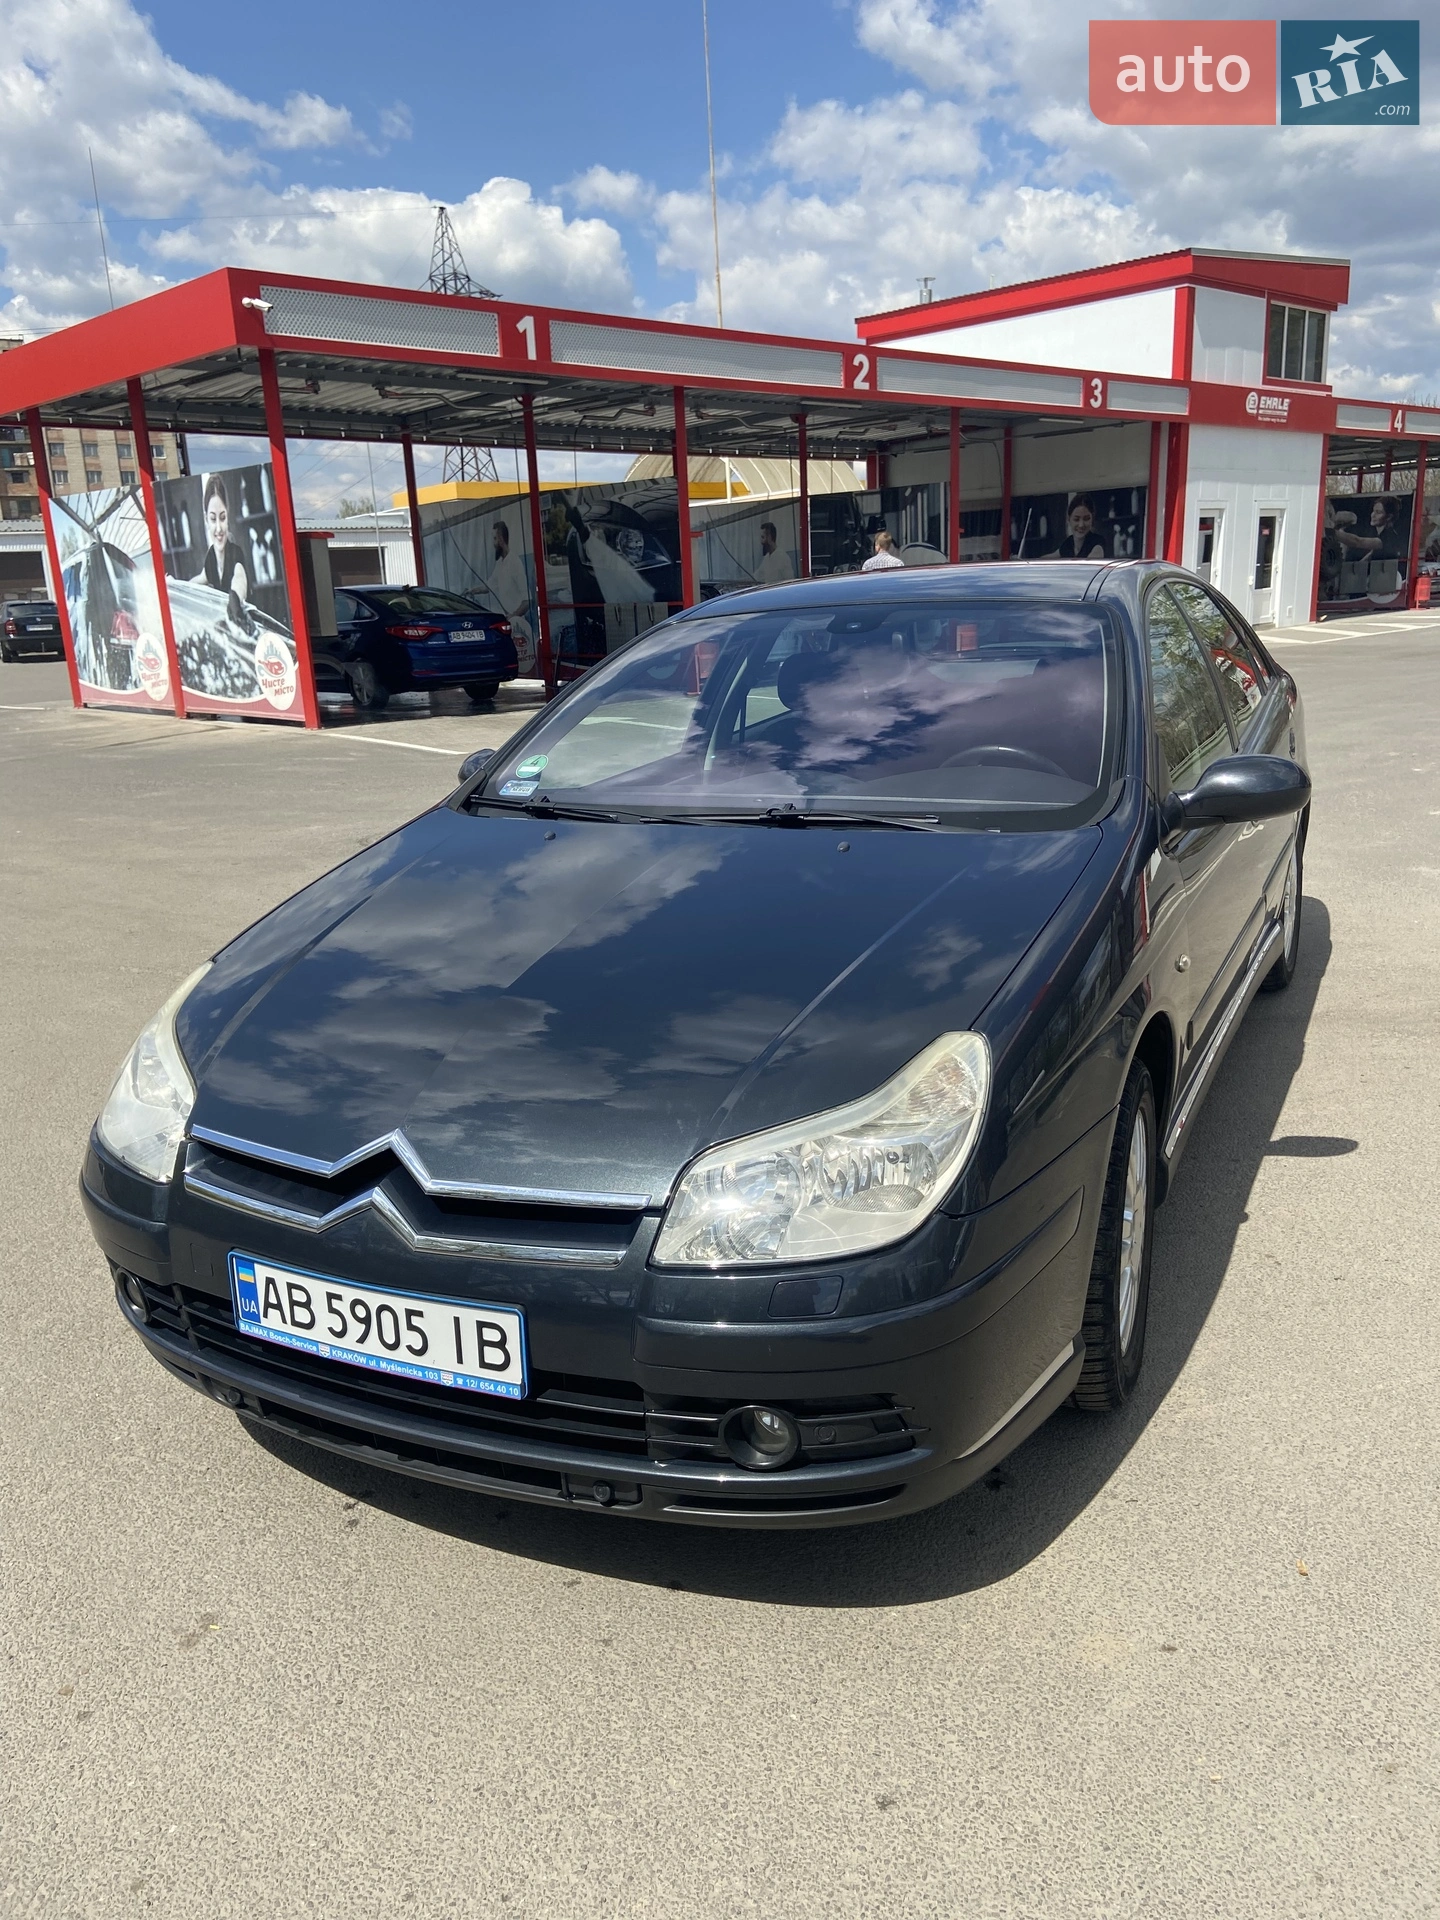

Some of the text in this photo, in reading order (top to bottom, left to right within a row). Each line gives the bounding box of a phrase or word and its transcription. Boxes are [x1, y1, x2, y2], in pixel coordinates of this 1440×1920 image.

[516, 315, 537, 361] 1
[853, 353, 870, 390] 2
[1090, 378, 1103, 409] 3
[1394, 409, 1402, 433] 4
[261, 677, 286, 689] Чисте
[274, 685, 294, 696] місто
[242, 1297, 258, 1315] UA
[262, 1275, 511, 1372] AB 5905 IB
[240, 1322, 269, 1338] BAJMAX
[269, 1331, 317, 1352] Bosch-Service
[331, 1349, 367, 1364] KRAKÓW
[368, 1360, 378, 1368] ul.
[380, 1360, 423, 1378] Myślenicka
[424, 1371, 438, 1380] 103
[465, 1379, 477, 1388] 12/
[479, 1381, 494, 1391] 654
[496, 1385, 506, 1394] 40
[508, 1386, 519, 1396] 10
